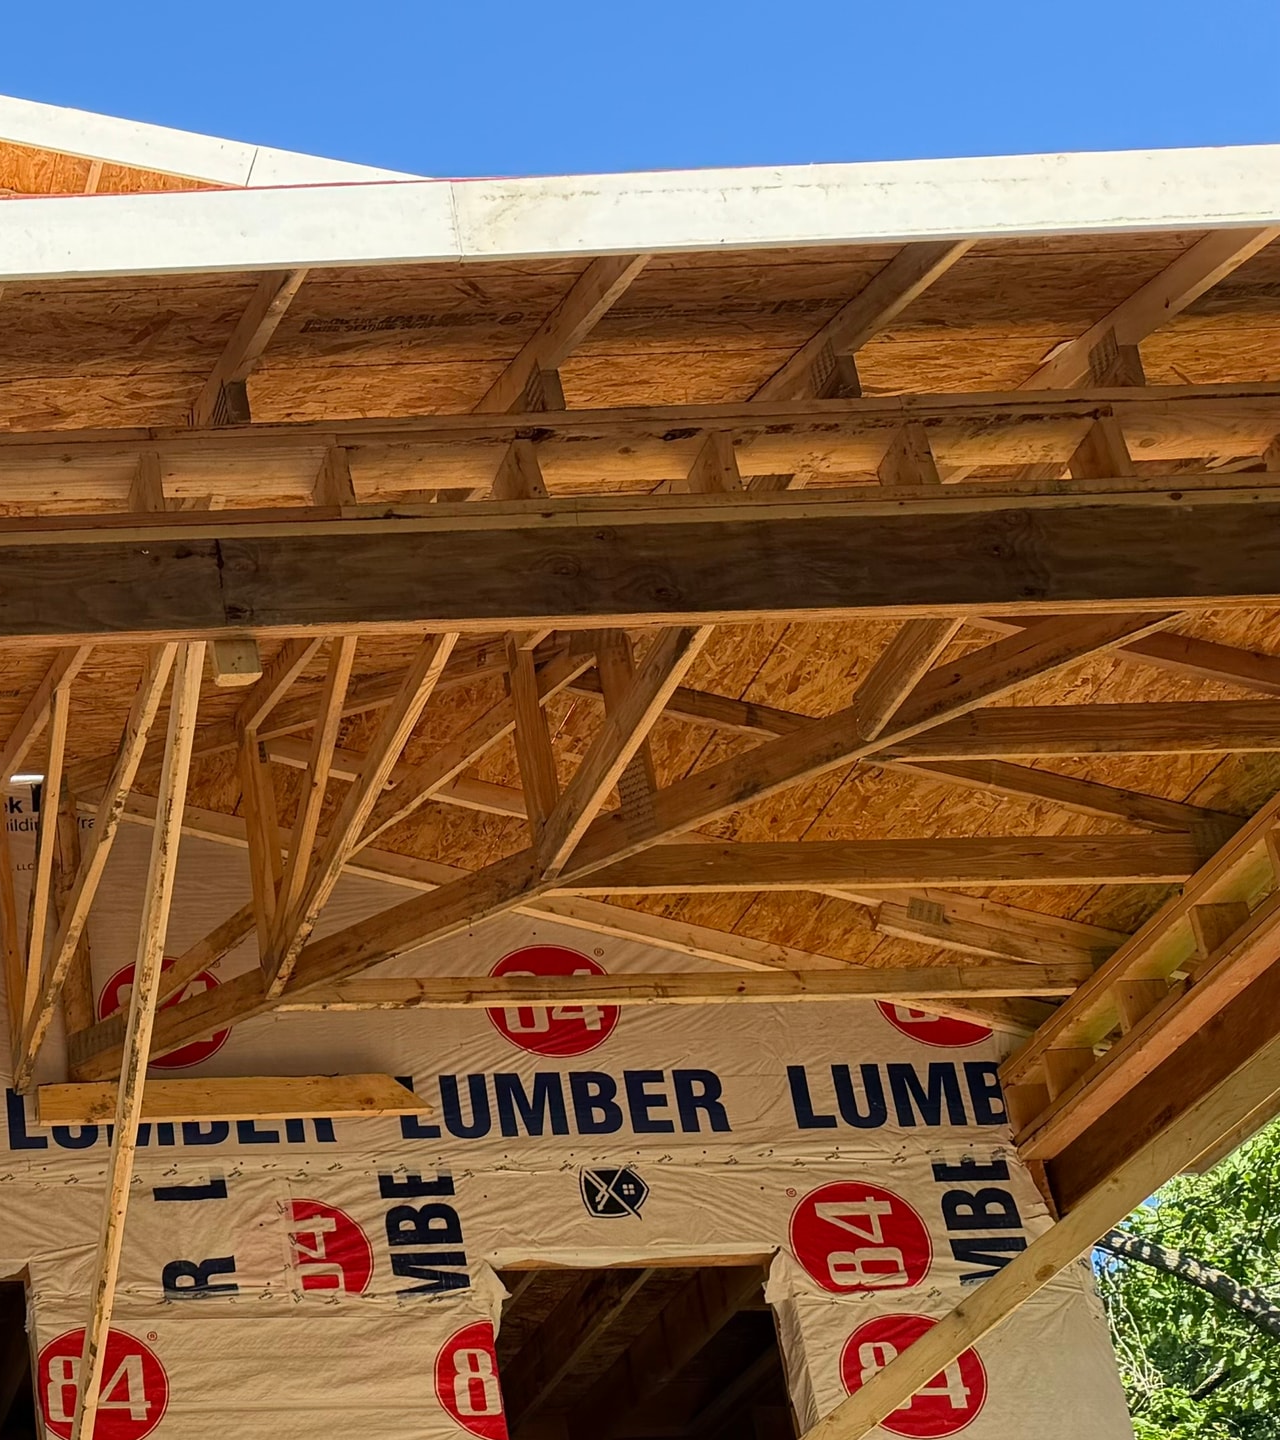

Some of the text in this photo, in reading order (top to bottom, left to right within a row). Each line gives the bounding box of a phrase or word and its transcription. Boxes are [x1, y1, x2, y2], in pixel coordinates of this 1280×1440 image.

[394, 1068, 732, 1140] LUMBER
[813, 1197, 913, 1289] 84
[46, 1353, 151, 1422] 84
